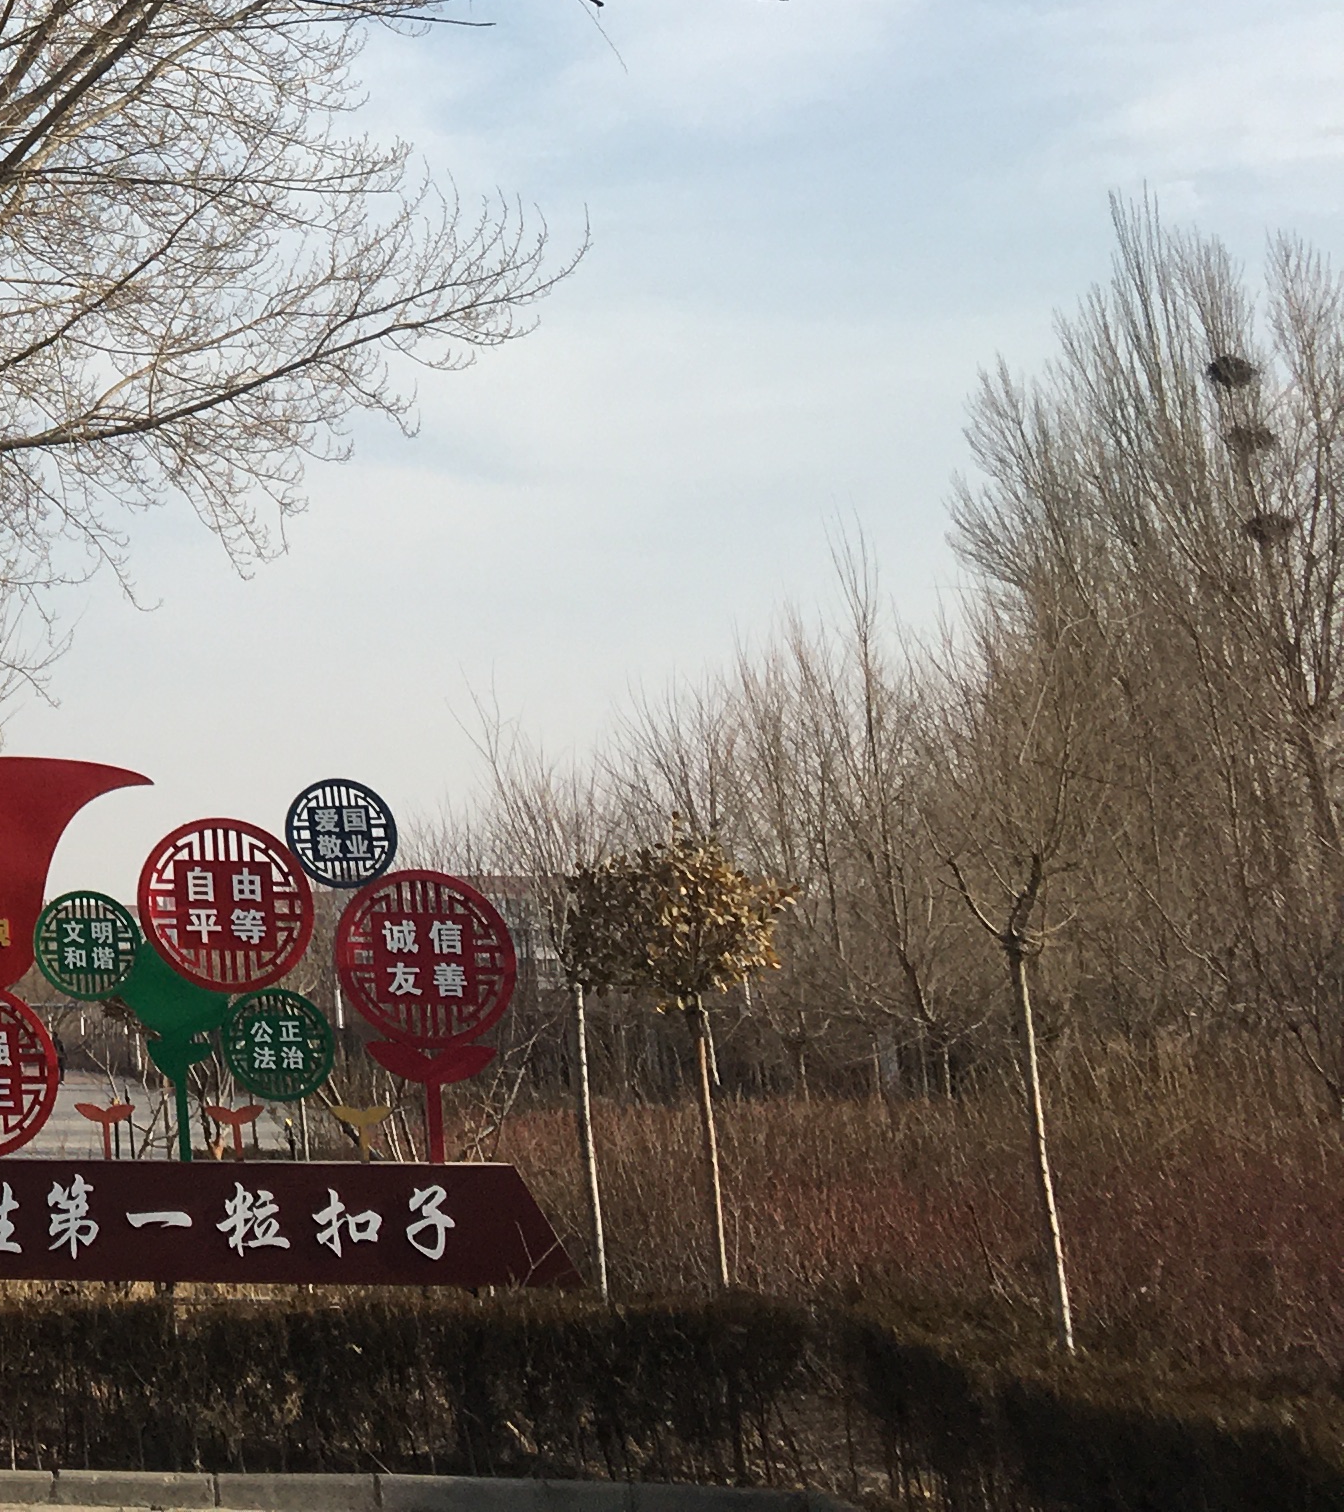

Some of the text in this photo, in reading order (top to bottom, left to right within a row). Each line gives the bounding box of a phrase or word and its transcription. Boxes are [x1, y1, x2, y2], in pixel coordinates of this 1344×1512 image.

[314, 808, 368, 833] 爱国
[316, 834, 372, 859] 敬业
[186, 866, 262, 902] 自由
[62, 920, 113, 944] 文明
[186, 908, 267, 945] 平等
[381, 919, 463, 955] 诚信
[63, 946, 115, 970] 和谐
[386, 962, 468, 998] 友善
[250, 1020, 303, 1043] 公正
[252, 1045, 305, 1070] 法治
